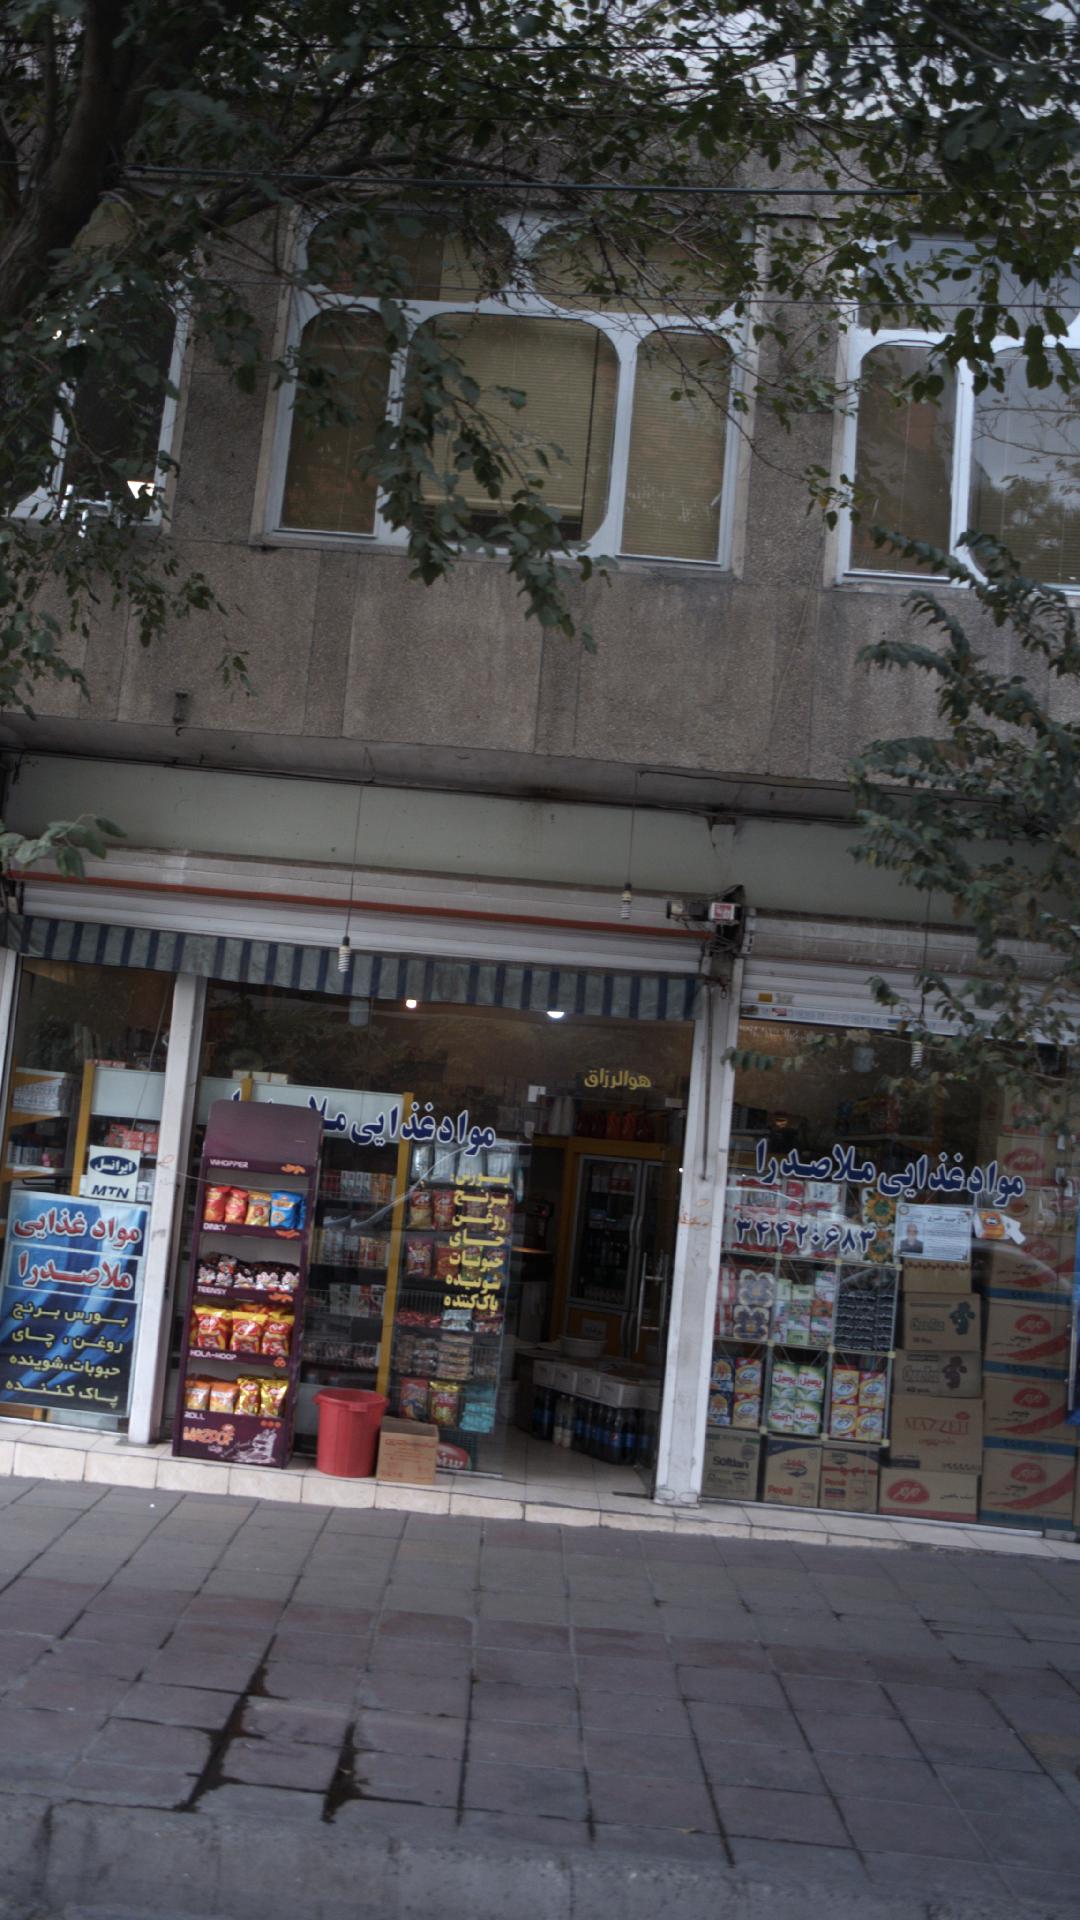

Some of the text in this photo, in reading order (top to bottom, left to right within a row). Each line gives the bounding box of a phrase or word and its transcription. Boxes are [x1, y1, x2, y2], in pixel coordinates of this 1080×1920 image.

[352, 1101, 437, 1147] غذایی
[437, 1109, 497, 1156] مواد
[94, 1158, 133, 1175] ایرانسل
[756, 1138, 877, 1185] ملاصدرا
[878, 1151, 967, 1198] غذایی
[91, 1184, 130, 1199] MTN
[453, 1189, 510, 1209] برنج
[966, 1161, 1027, 1207] مواد
[13, 1207, 142, 1249] مواد غذایی
[452, 1209, 507, 1231] روغن
[18, 1250, 133, 1290] ملاصدرا
[12, 1302, 129, 1328] بورس برنج
[11, 1326, 55, 1349] چای
[5, 1380, 119, 1409] پاک کننده
